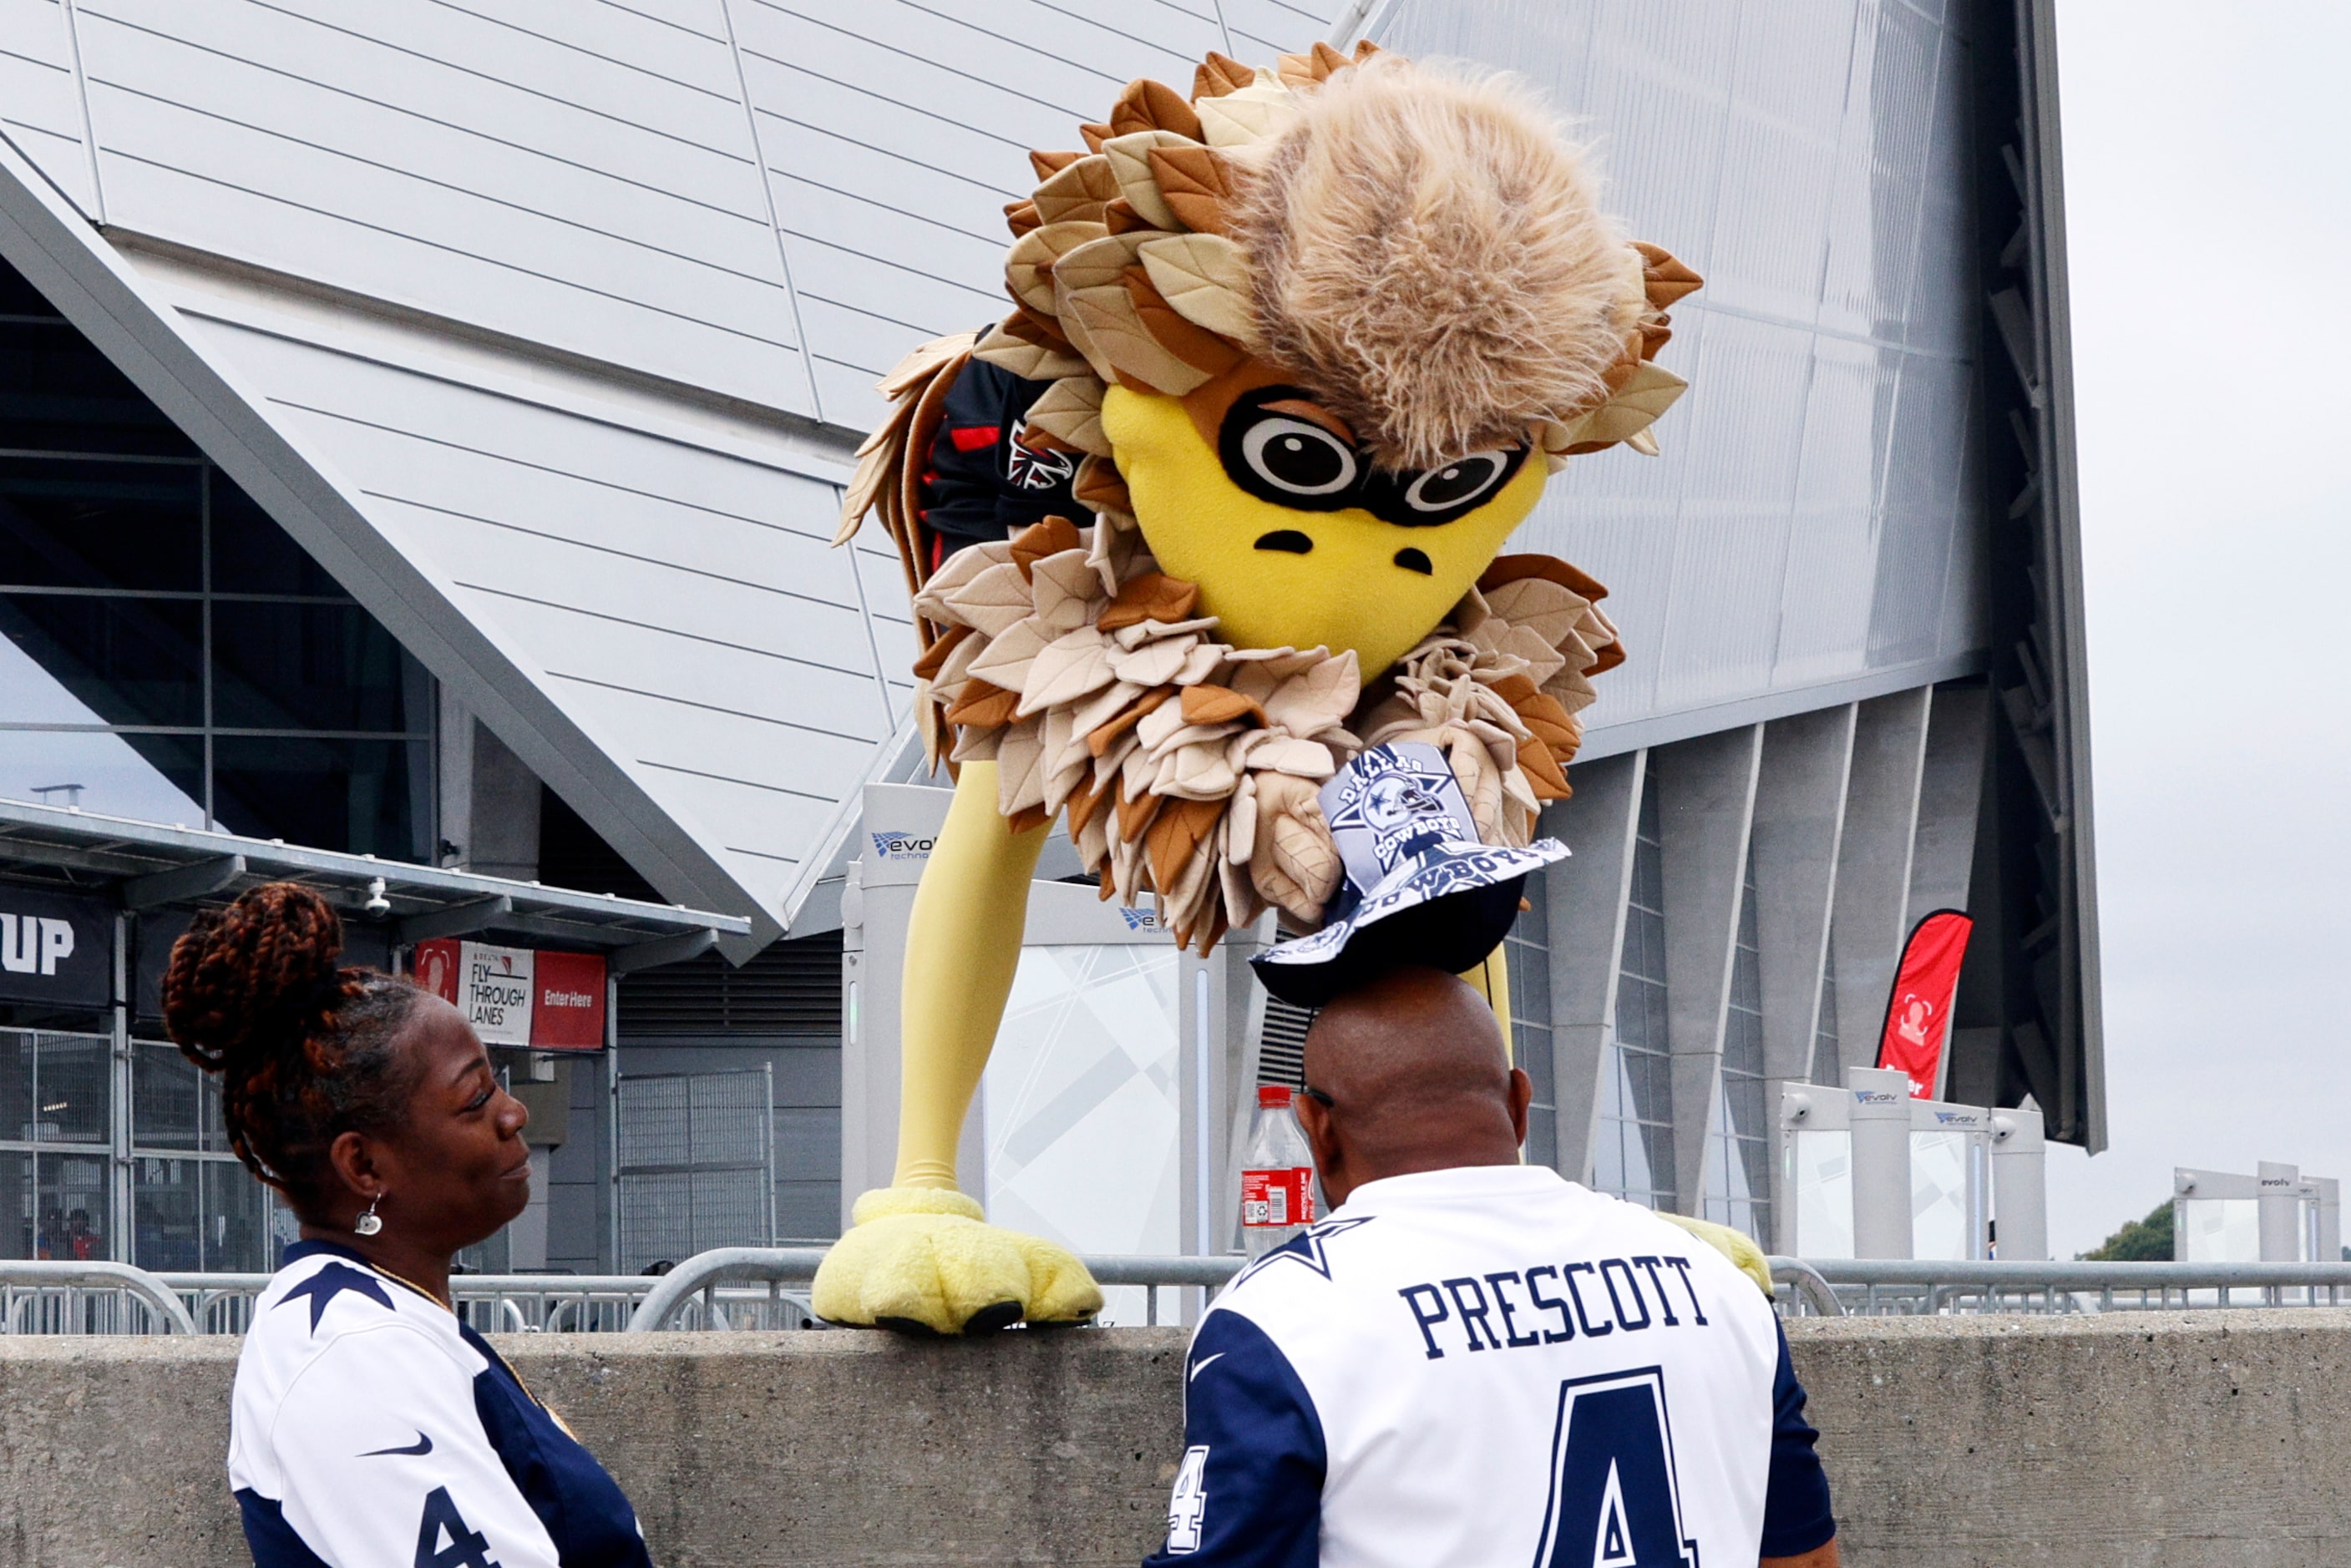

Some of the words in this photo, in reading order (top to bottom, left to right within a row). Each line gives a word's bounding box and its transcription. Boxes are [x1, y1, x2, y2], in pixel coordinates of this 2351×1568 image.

[1339, 756, 1423, 804] DALLAS
[890, 837, 937, 852] evo
[1373, 816, 1461, 859] COWBOYS
[0, 913, 74, 976] UP
[472, 964, 491, 983] FLY
[469, 1004, 504, 1025] LANES
[470, 984, 526, 1007] THROUGH
[545, 989, 569, 1006] Enter
[570, 991, 592, 1008] Here
[2261, 1178, 2291, 1186] evolv
[1397, 1256, 1709, 1360] PRESCOTT
[1533, 1364, 1700, 1568] 4
[1167, 1445, 1210, 1555] 4
[413, 1485, 503, 1568] 4
